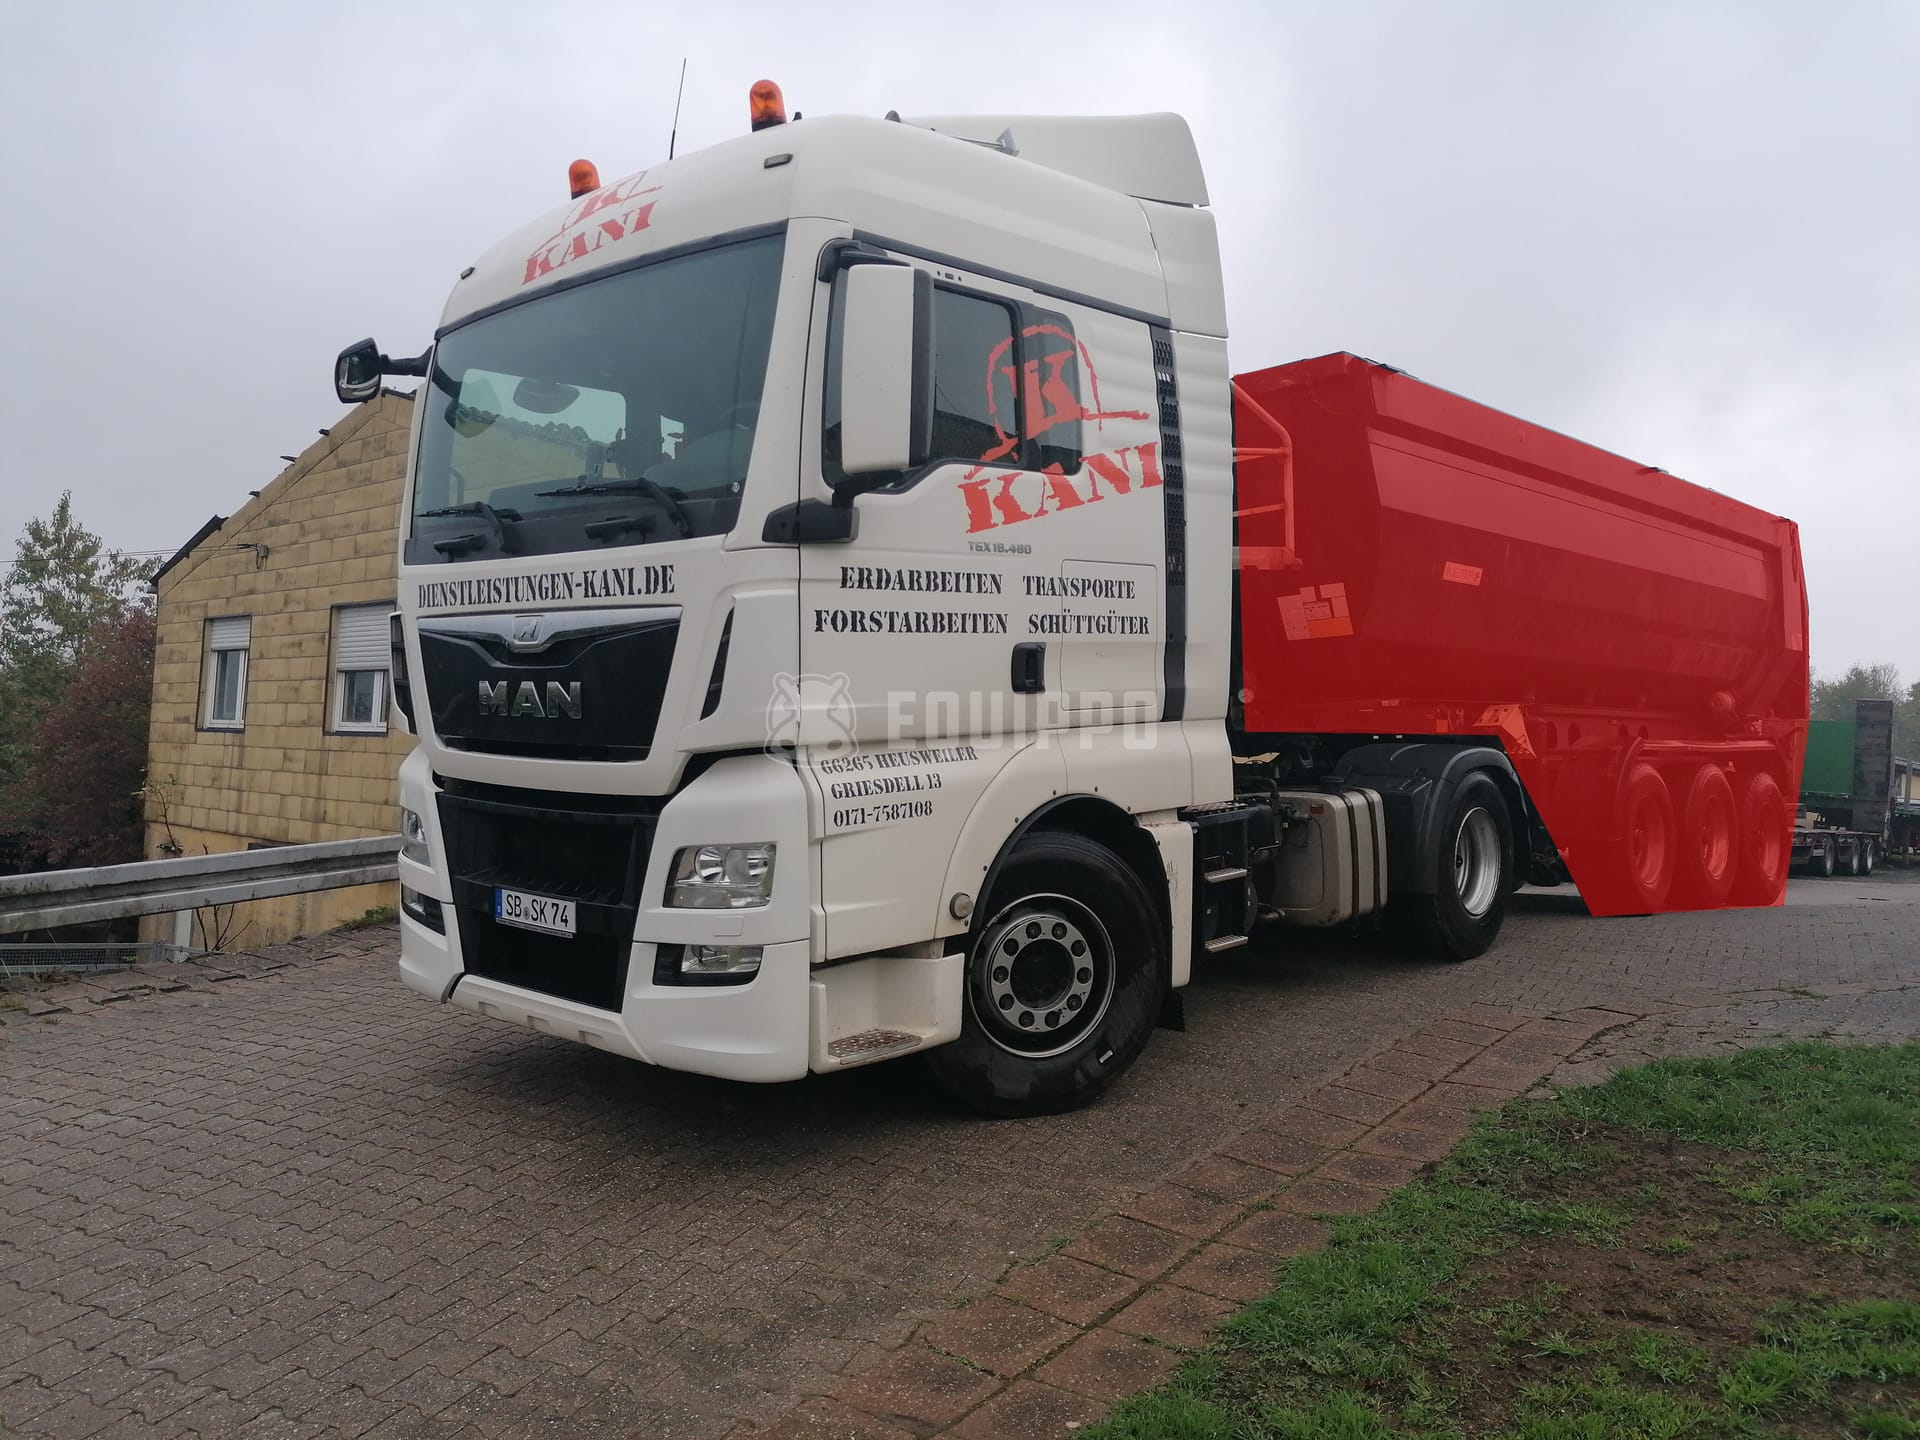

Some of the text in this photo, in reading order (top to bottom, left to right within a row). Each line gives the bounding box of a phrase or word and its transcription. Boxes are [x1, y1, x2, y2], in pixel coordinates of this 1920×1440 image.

[521, 199, 658, 285] KANI
[958, 441, 1163, 534] KANI
[418, 564, 676, 609] DIENSTLEISTUNGEN-KANI.DE
[839, 566, 1136, 600] ERDARBEITEN TRANSPORTE
[814, 609, 1151, 636] FORSTARBEITEN SCHÜTTGÜTER
[478, 680, 582, 719] MAN
[820, 745, 979, 775] 66265 HEUSWEILER
[830, 773, 942, 800] GRIESDELL 13
[833, 800, 934, 828] 0171-7587108
[505, 893, 569, 928] SB SK 74
